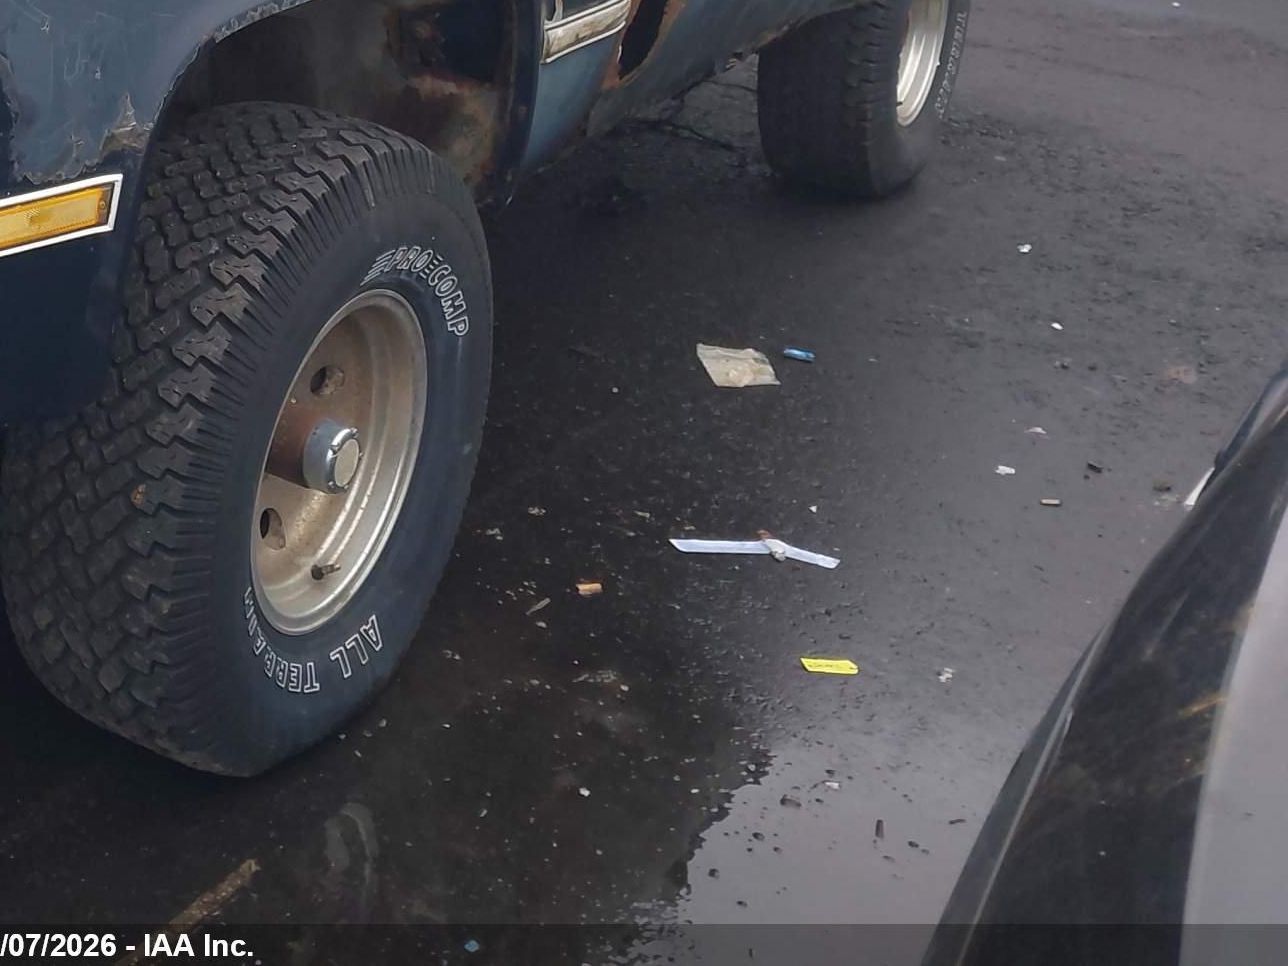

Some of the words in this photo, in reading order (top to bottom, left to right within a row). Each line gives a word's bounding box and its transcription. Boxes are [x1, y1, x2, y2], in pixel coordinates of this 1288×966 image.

[428, 264, 469, 336] COMP
[243, 586, 321, 694] TERRAIN
[329, 613, 383, 679] ALL
